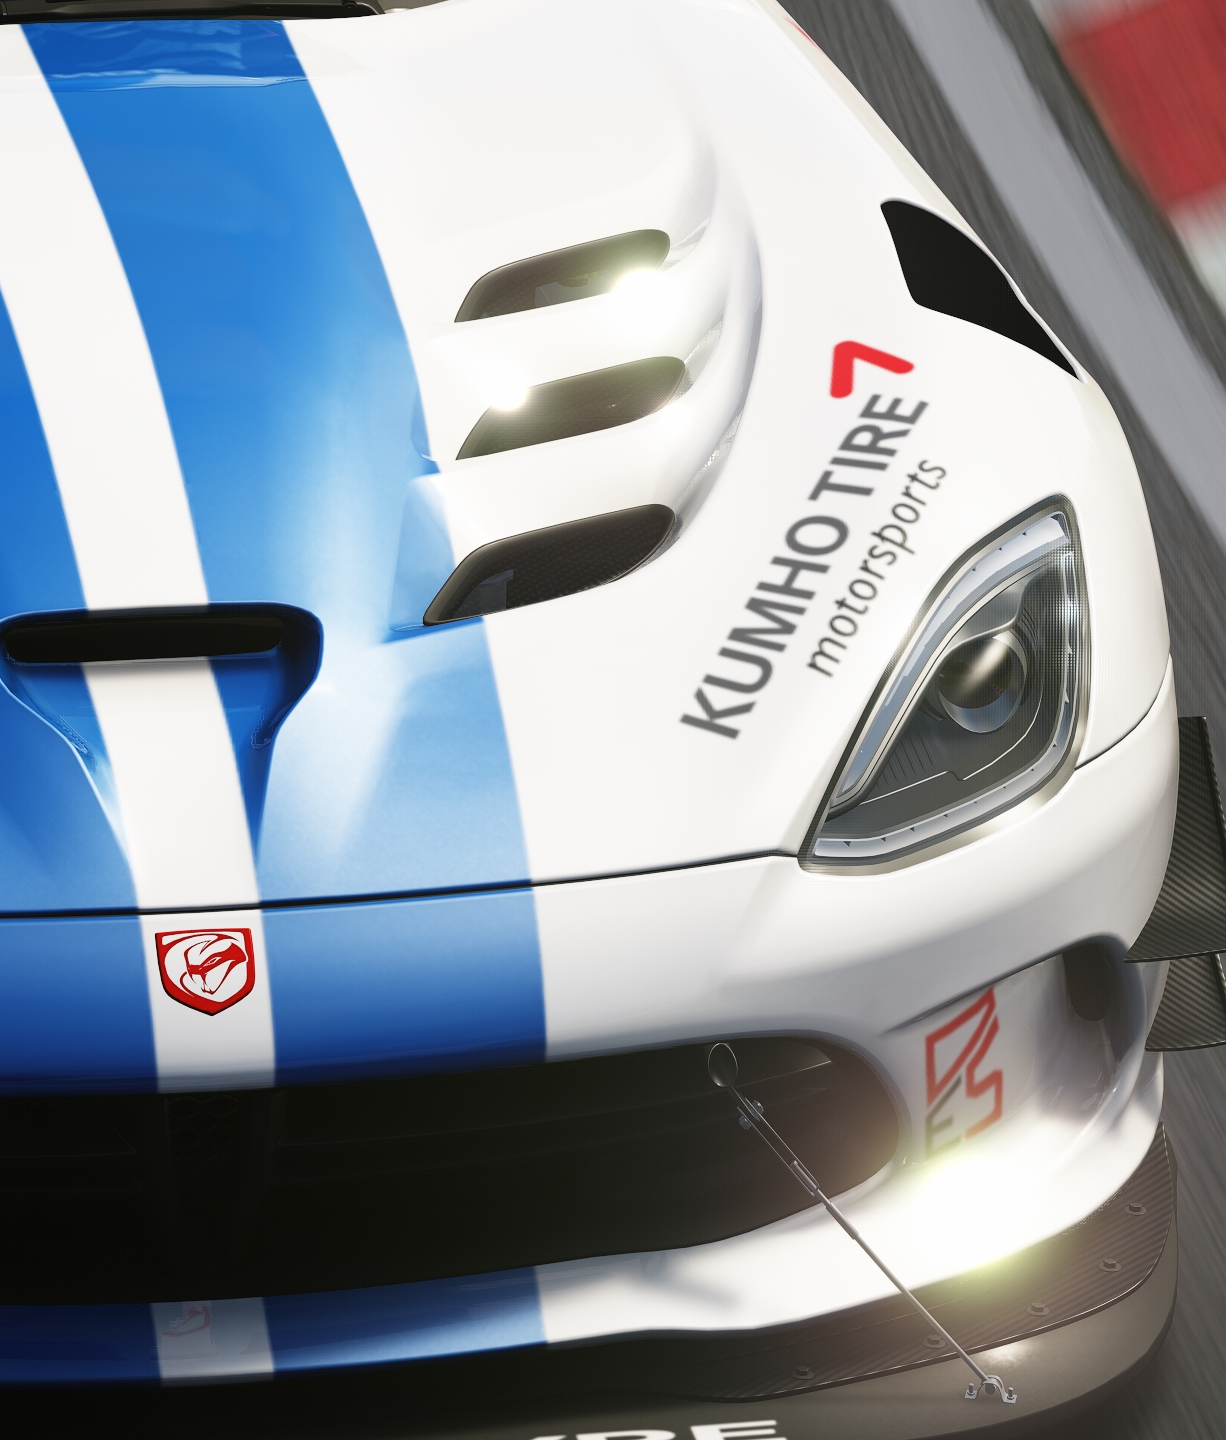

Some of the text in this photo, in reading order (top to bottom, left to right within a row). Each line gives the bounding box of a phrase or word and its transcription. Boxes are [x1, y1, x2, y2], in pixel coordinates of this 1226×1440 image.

[680, 394, 929, 740] KUMHO TIRE
[807, 458, 949, 678] motorsports
